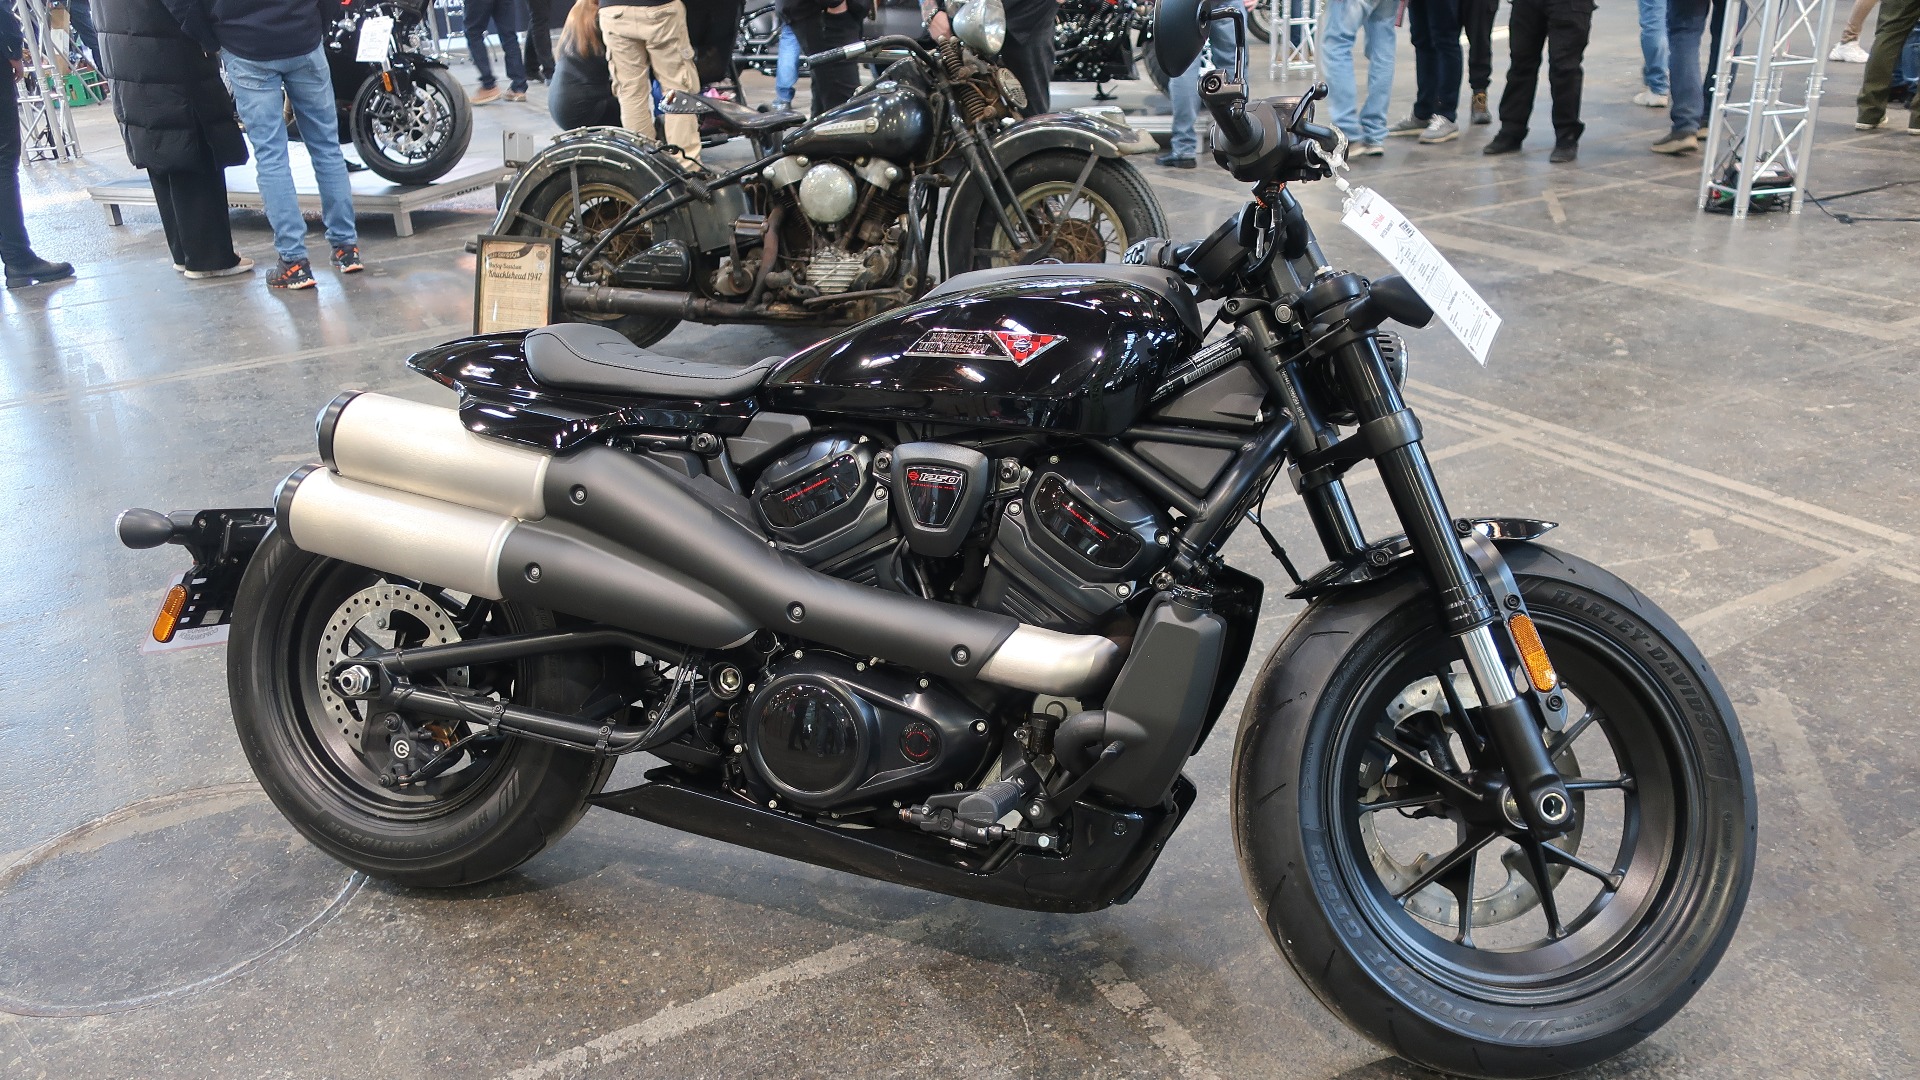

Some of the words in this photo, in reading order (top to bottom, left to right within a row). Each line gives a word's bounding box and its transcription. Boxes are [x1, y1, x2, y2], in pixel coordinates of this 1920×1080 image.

[488, 269, 527, 280] Knucklehead
[527, 272, 543, 281] 1947
[919, 472, 961, 484] 1250
[1551, 589, 1725, 762] HARLEY-DAVIDSON
[1311, 844, 1363, 939] GT503
[1363, 949, 1477, 1025] DUNLOP
